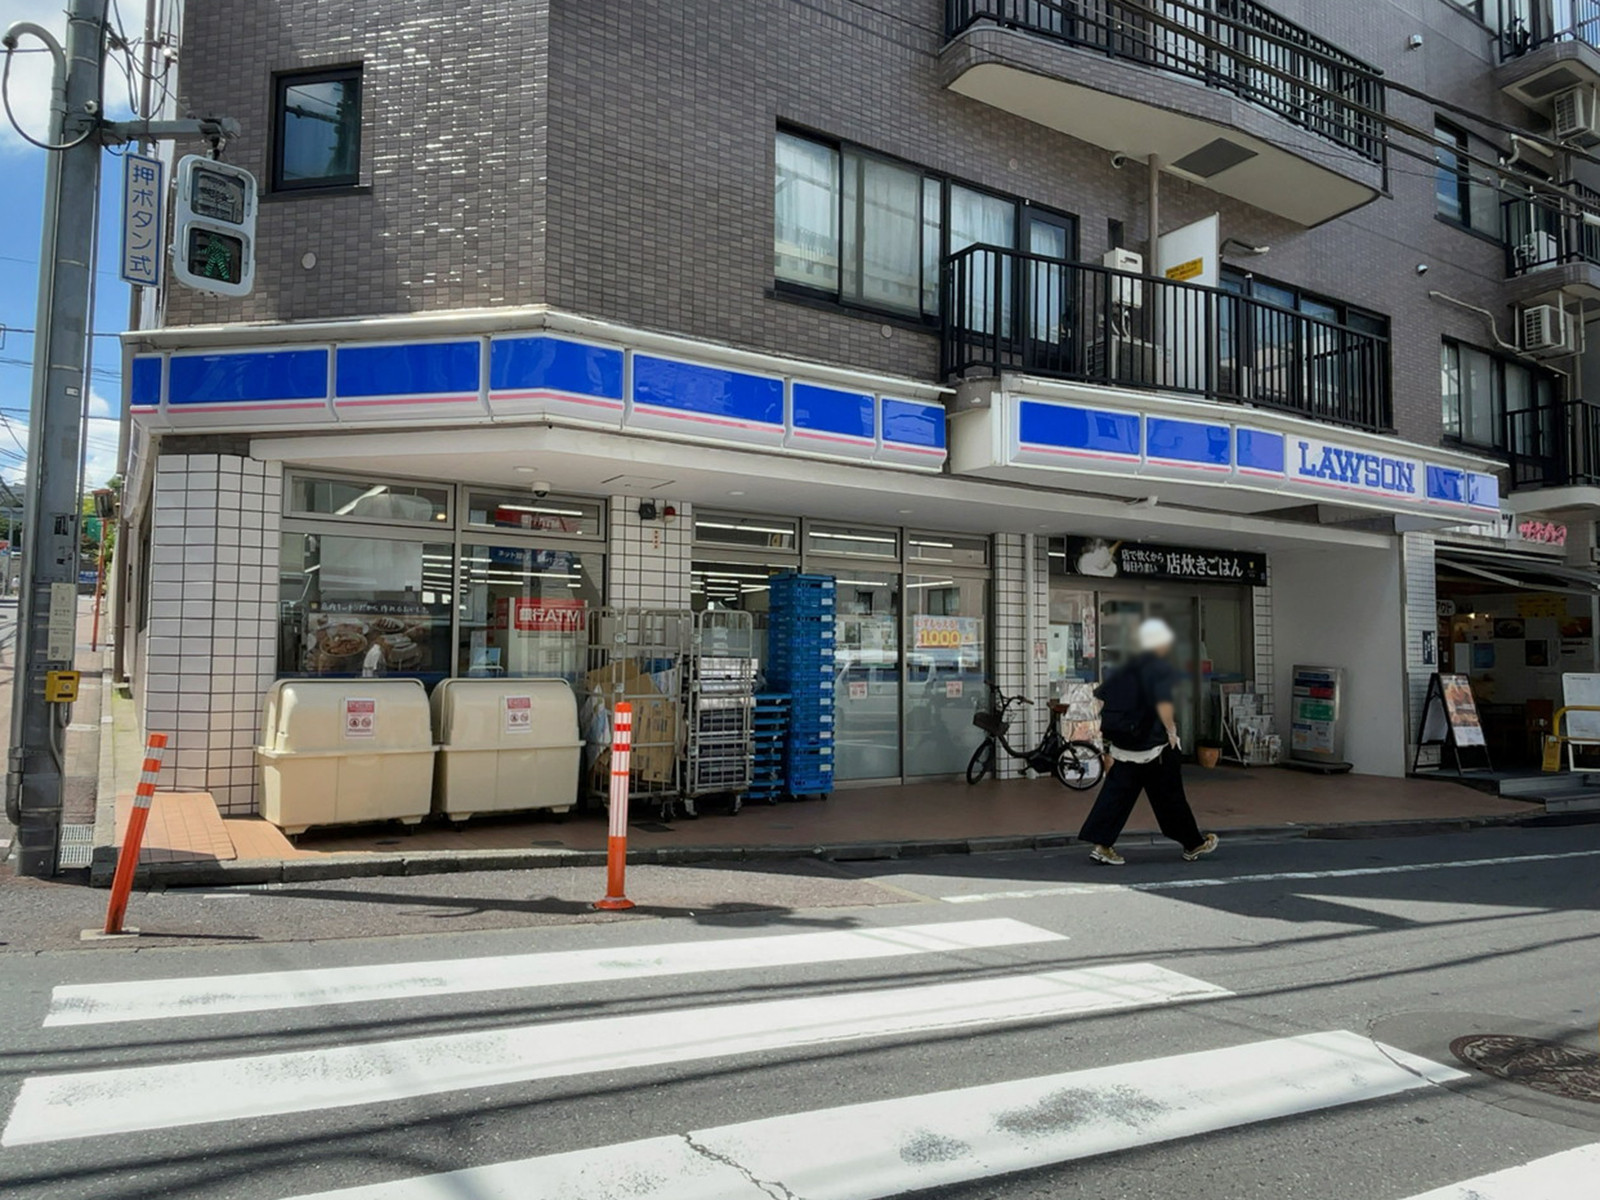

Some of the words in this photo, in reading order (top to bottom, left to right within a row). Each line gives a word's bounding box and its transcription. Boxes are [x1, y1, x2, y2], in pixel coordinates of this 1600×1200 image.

[1298, 441, 1416, 494] LAWSON
[1166, 553, 1244, 577] 店炊きごはん
[519, 607, 580, 623] 銀行ATM
